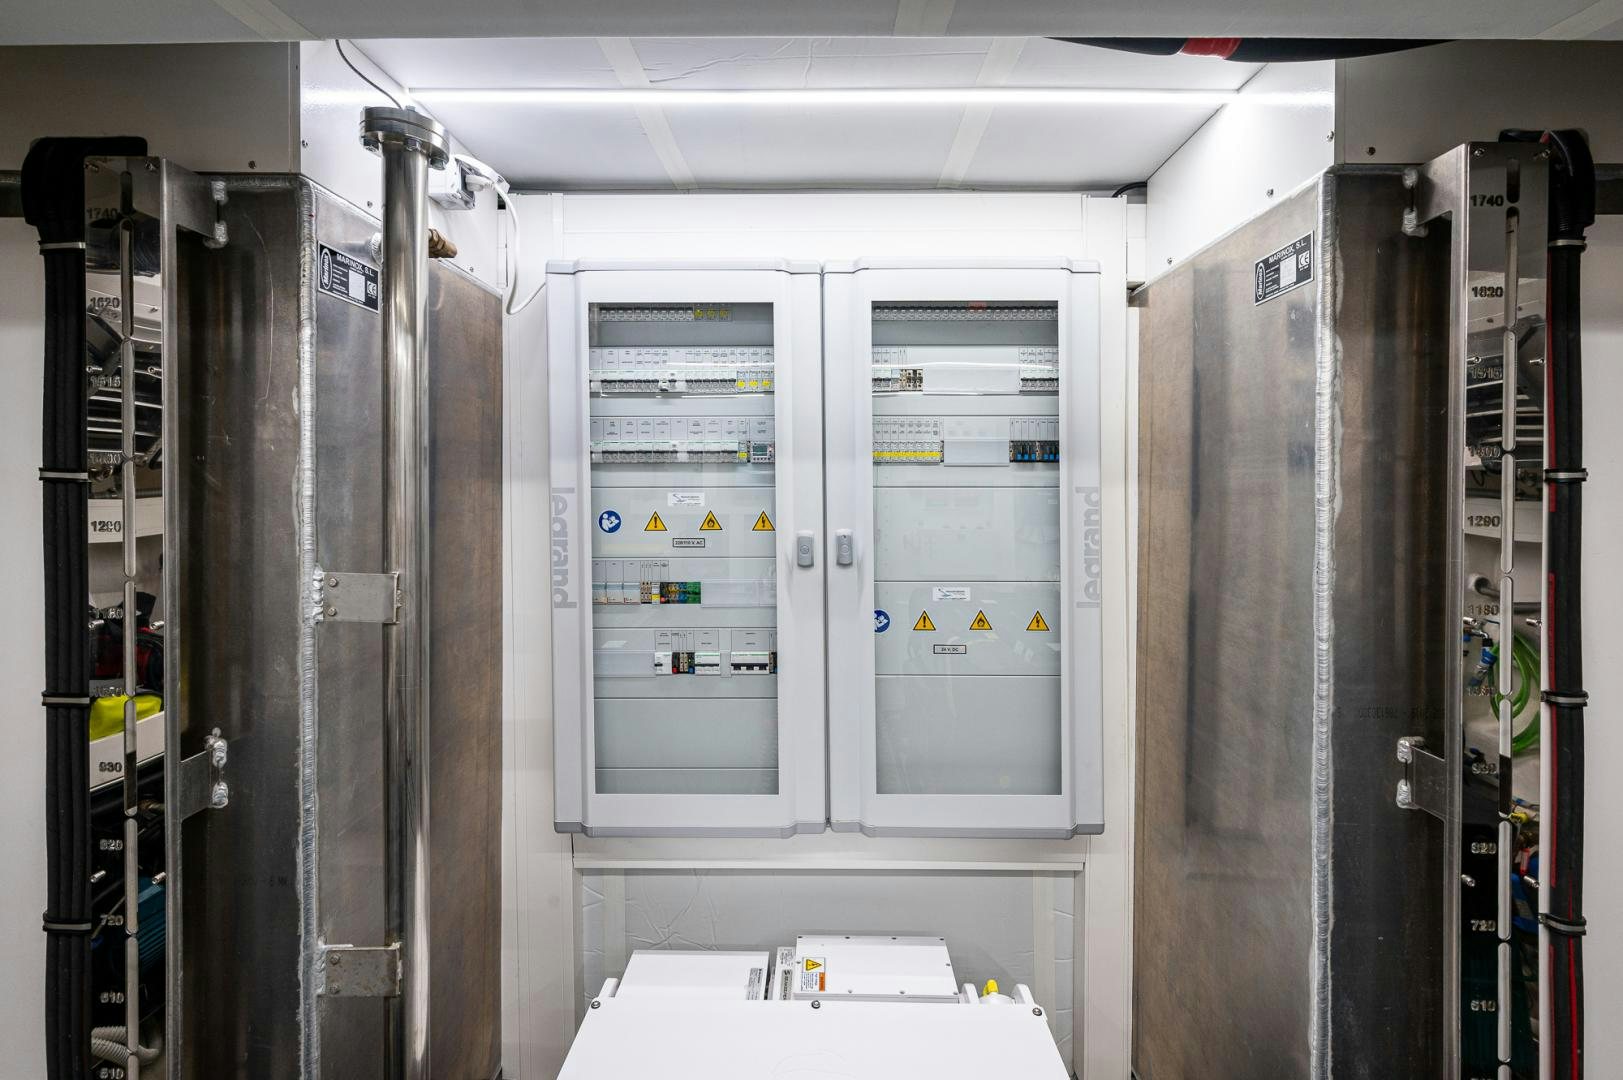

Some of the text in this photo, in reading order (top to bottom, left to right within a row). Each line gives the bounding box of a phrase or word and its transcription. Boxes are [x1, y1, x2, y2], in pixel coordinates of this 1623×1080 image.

[1469, 194, 1504, 207] 1740
[551, 487, 578, 609] legrand
[1075, 486, 1100, 609] legrand
[99, 914, 125, 927] 720
